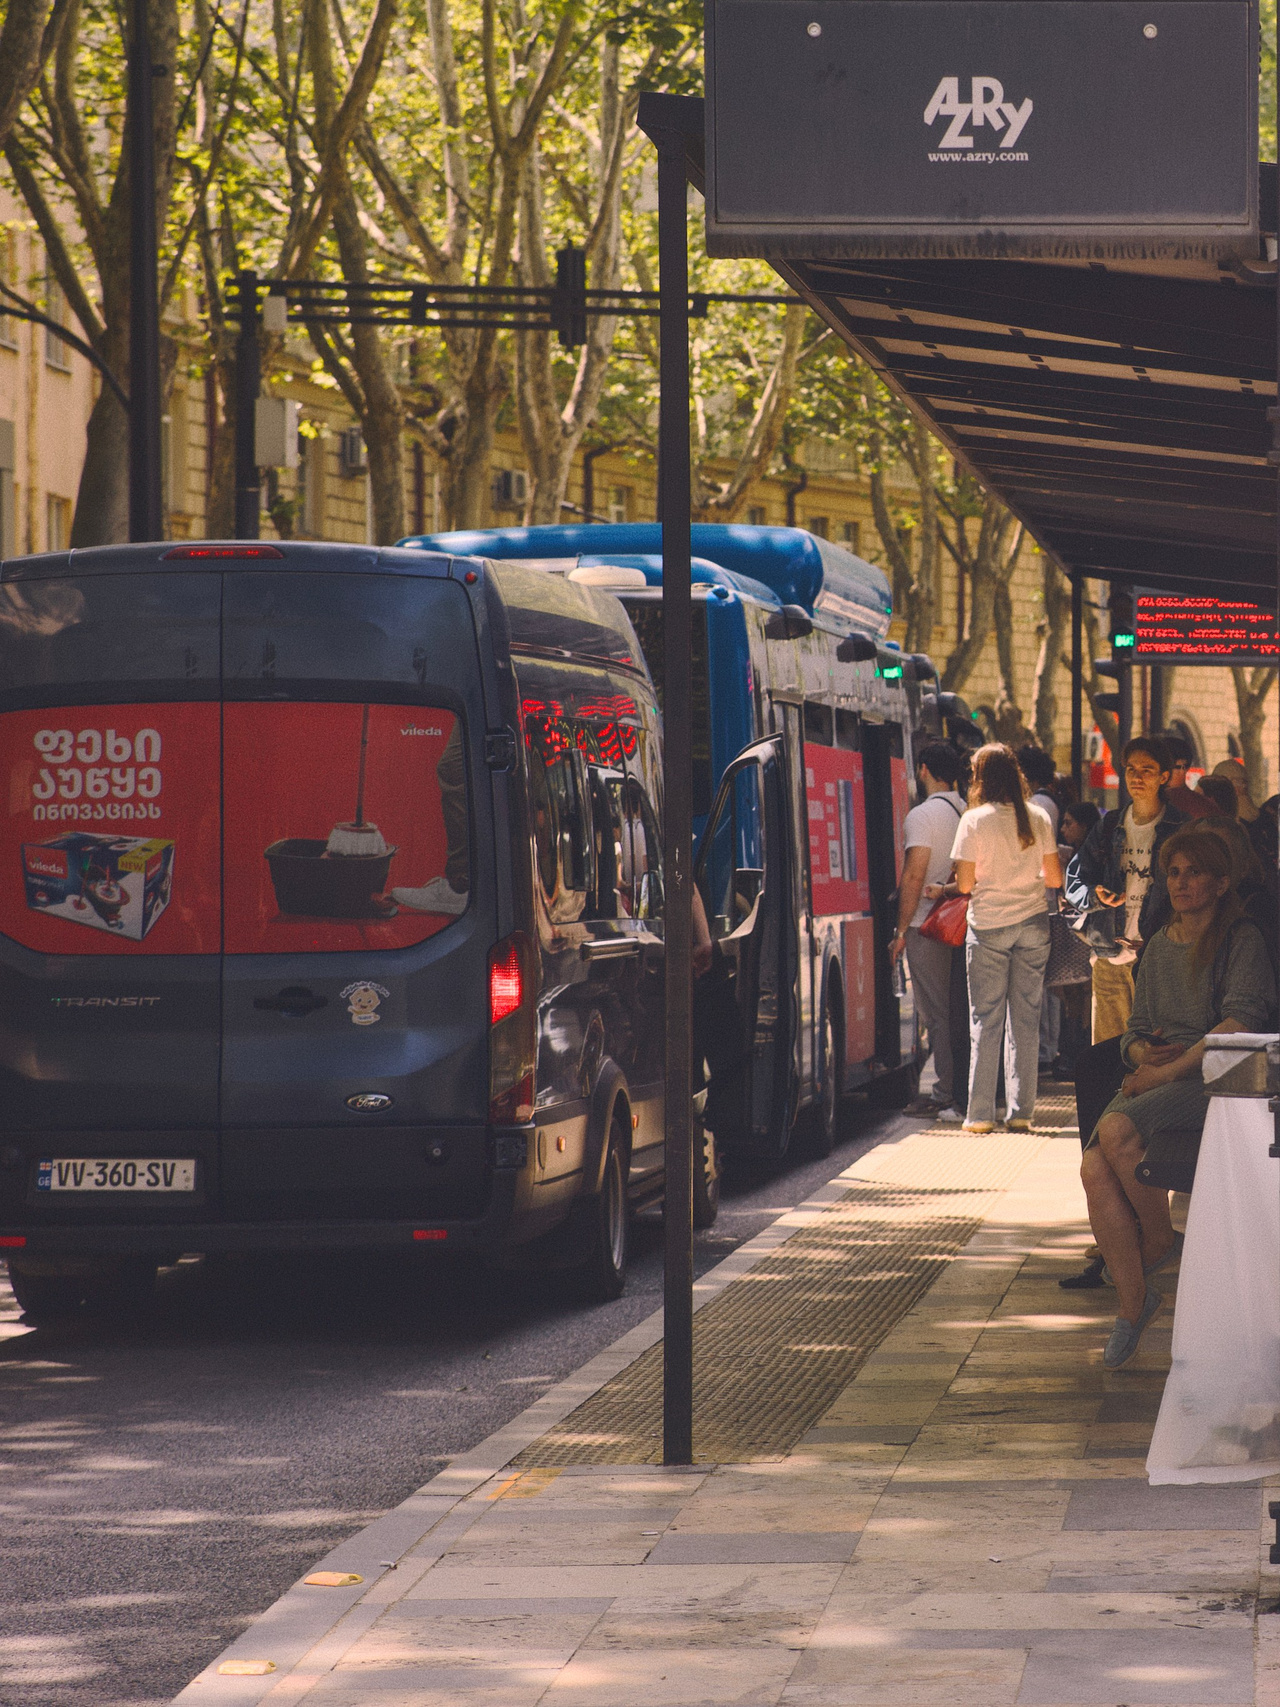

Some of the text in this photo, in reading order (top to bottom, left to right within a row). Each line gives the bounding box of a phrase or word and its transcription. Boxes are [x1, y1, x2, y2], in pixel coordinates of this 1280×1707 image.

[927, 150, 1030, 164] www.azry.com
[400, 724, 442, 736] vileda
[33, 728, 162, 764] ფეხი
[32, 767, 162, 799] აუწყე
[33, 802, 162, 821] ინოვაციას
[28, 860, 64, 875] vileda
[120, 860, 144, 872] NEW
[51, 996, 161, 1007] TRANSIT
[356, 1097, 382, 1108] Ford
[38, 1161, 176, 1188] GE VV-360-SV
